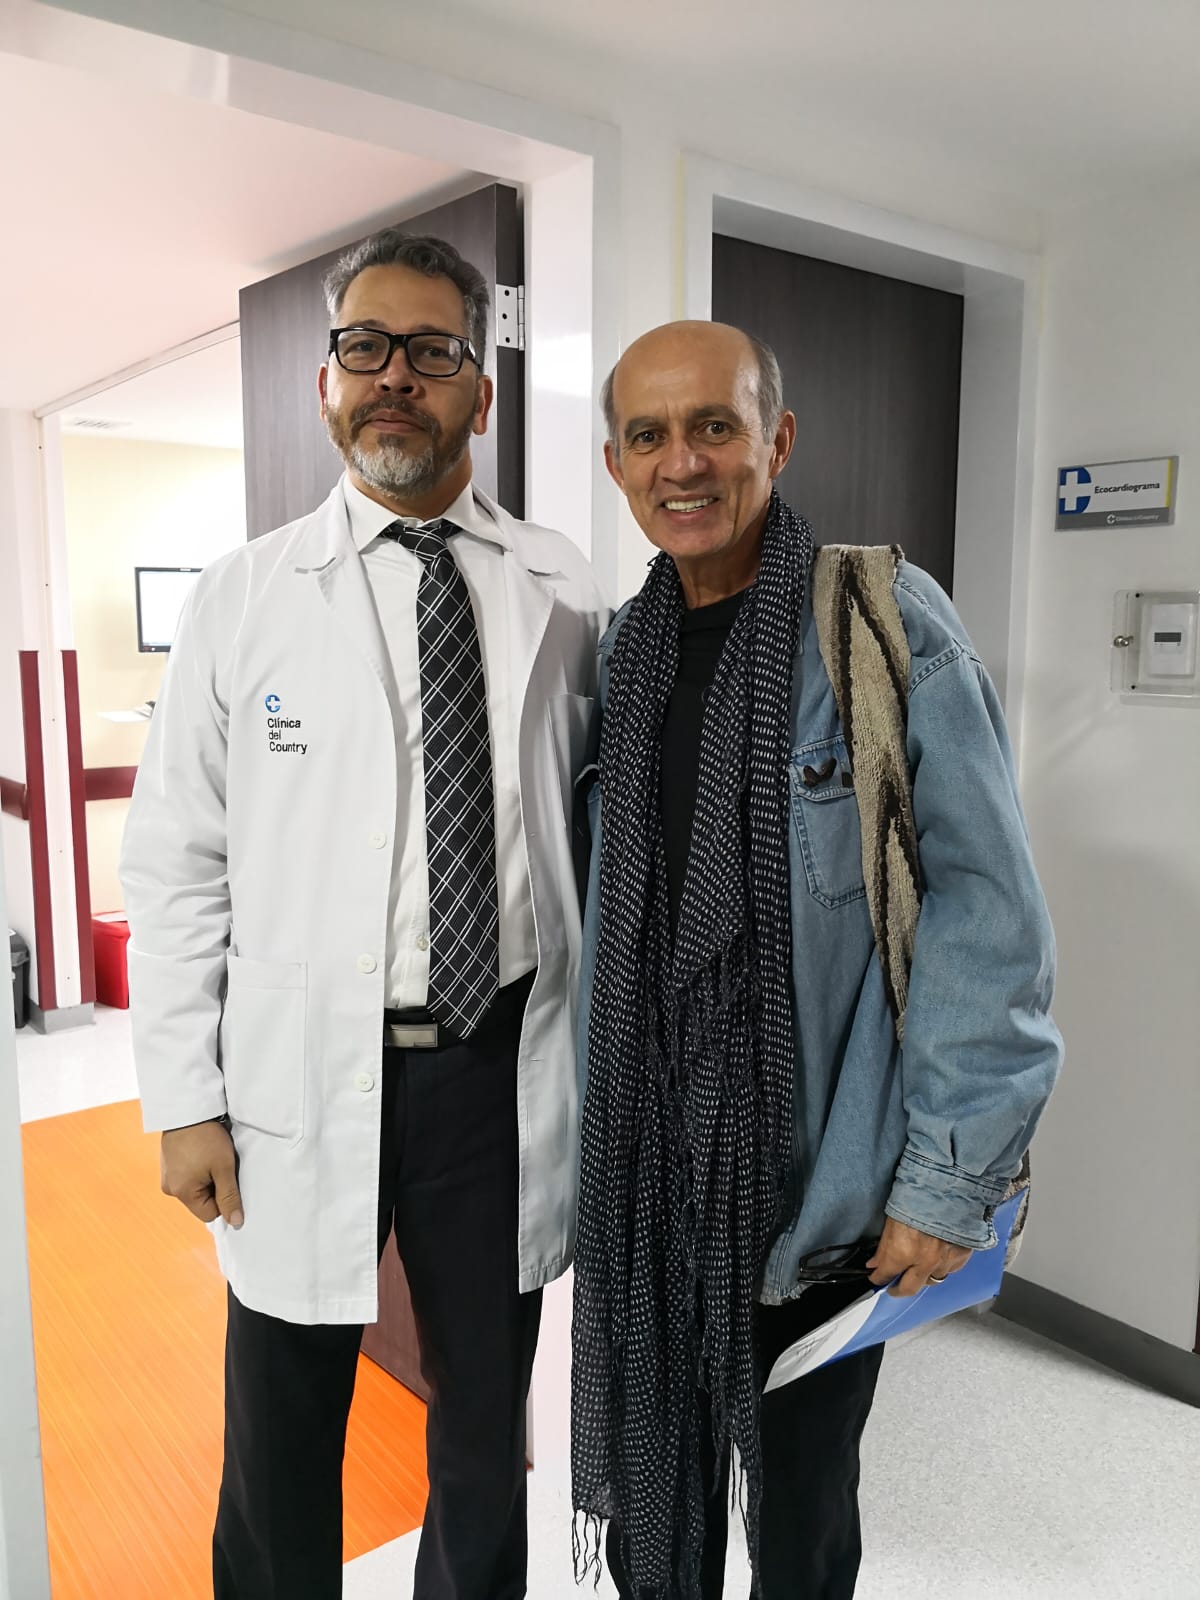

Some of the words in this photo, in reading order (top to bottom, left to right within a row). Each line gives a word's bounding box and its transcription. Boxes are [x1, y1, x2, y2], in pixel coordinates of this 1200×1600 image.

[1094, 482, 1161, 494] Ecocardiograma
[267, 717, 301, 728] Clínica
[268, 729, 282, 740] del
[269, 741, 308, 755] Country
